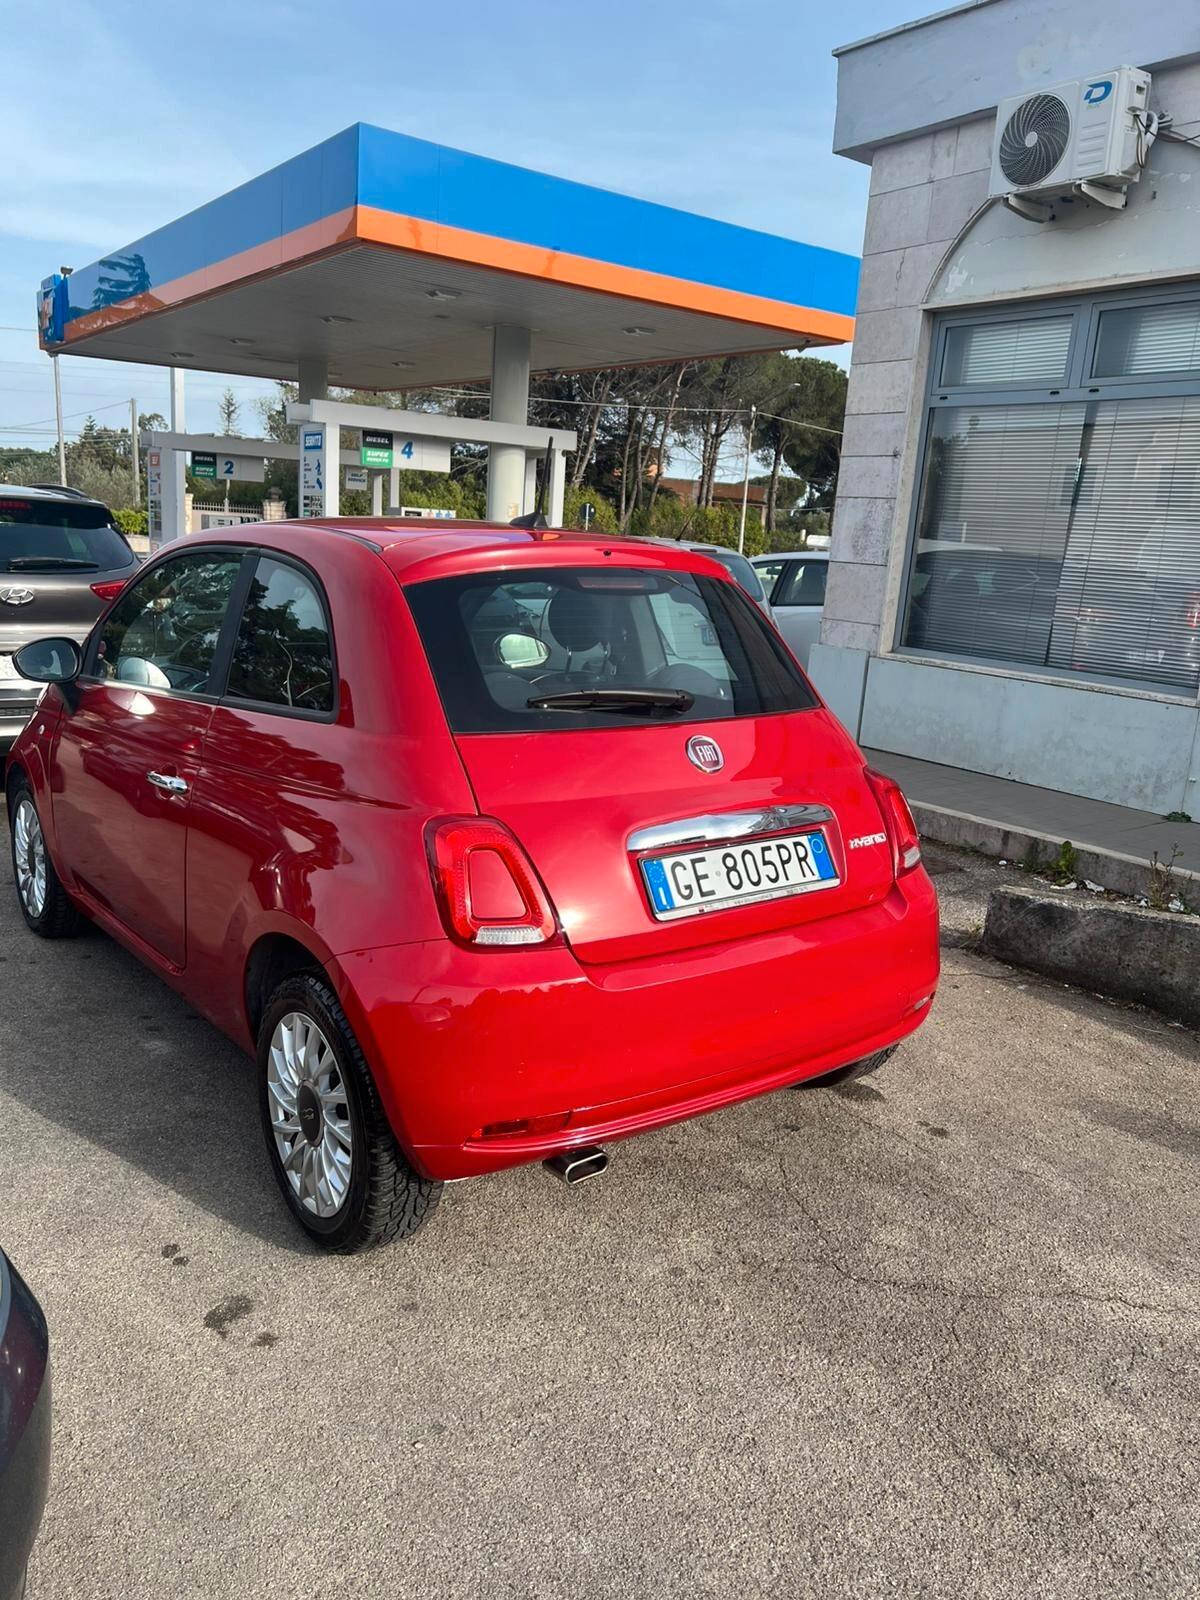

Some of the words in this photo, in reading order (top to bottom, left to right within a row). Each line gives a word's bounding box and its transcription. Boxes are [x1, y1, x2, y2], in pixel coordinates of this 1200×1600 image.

[402, 442, 414, 459] 4
[224, 461, 234, 474] 2
[696, 745, 718, 762] FIAT
[670, 856, 716, 901] GE
[721, 841, 815, 891] 805PR
[658, 887, 667, 905] I
